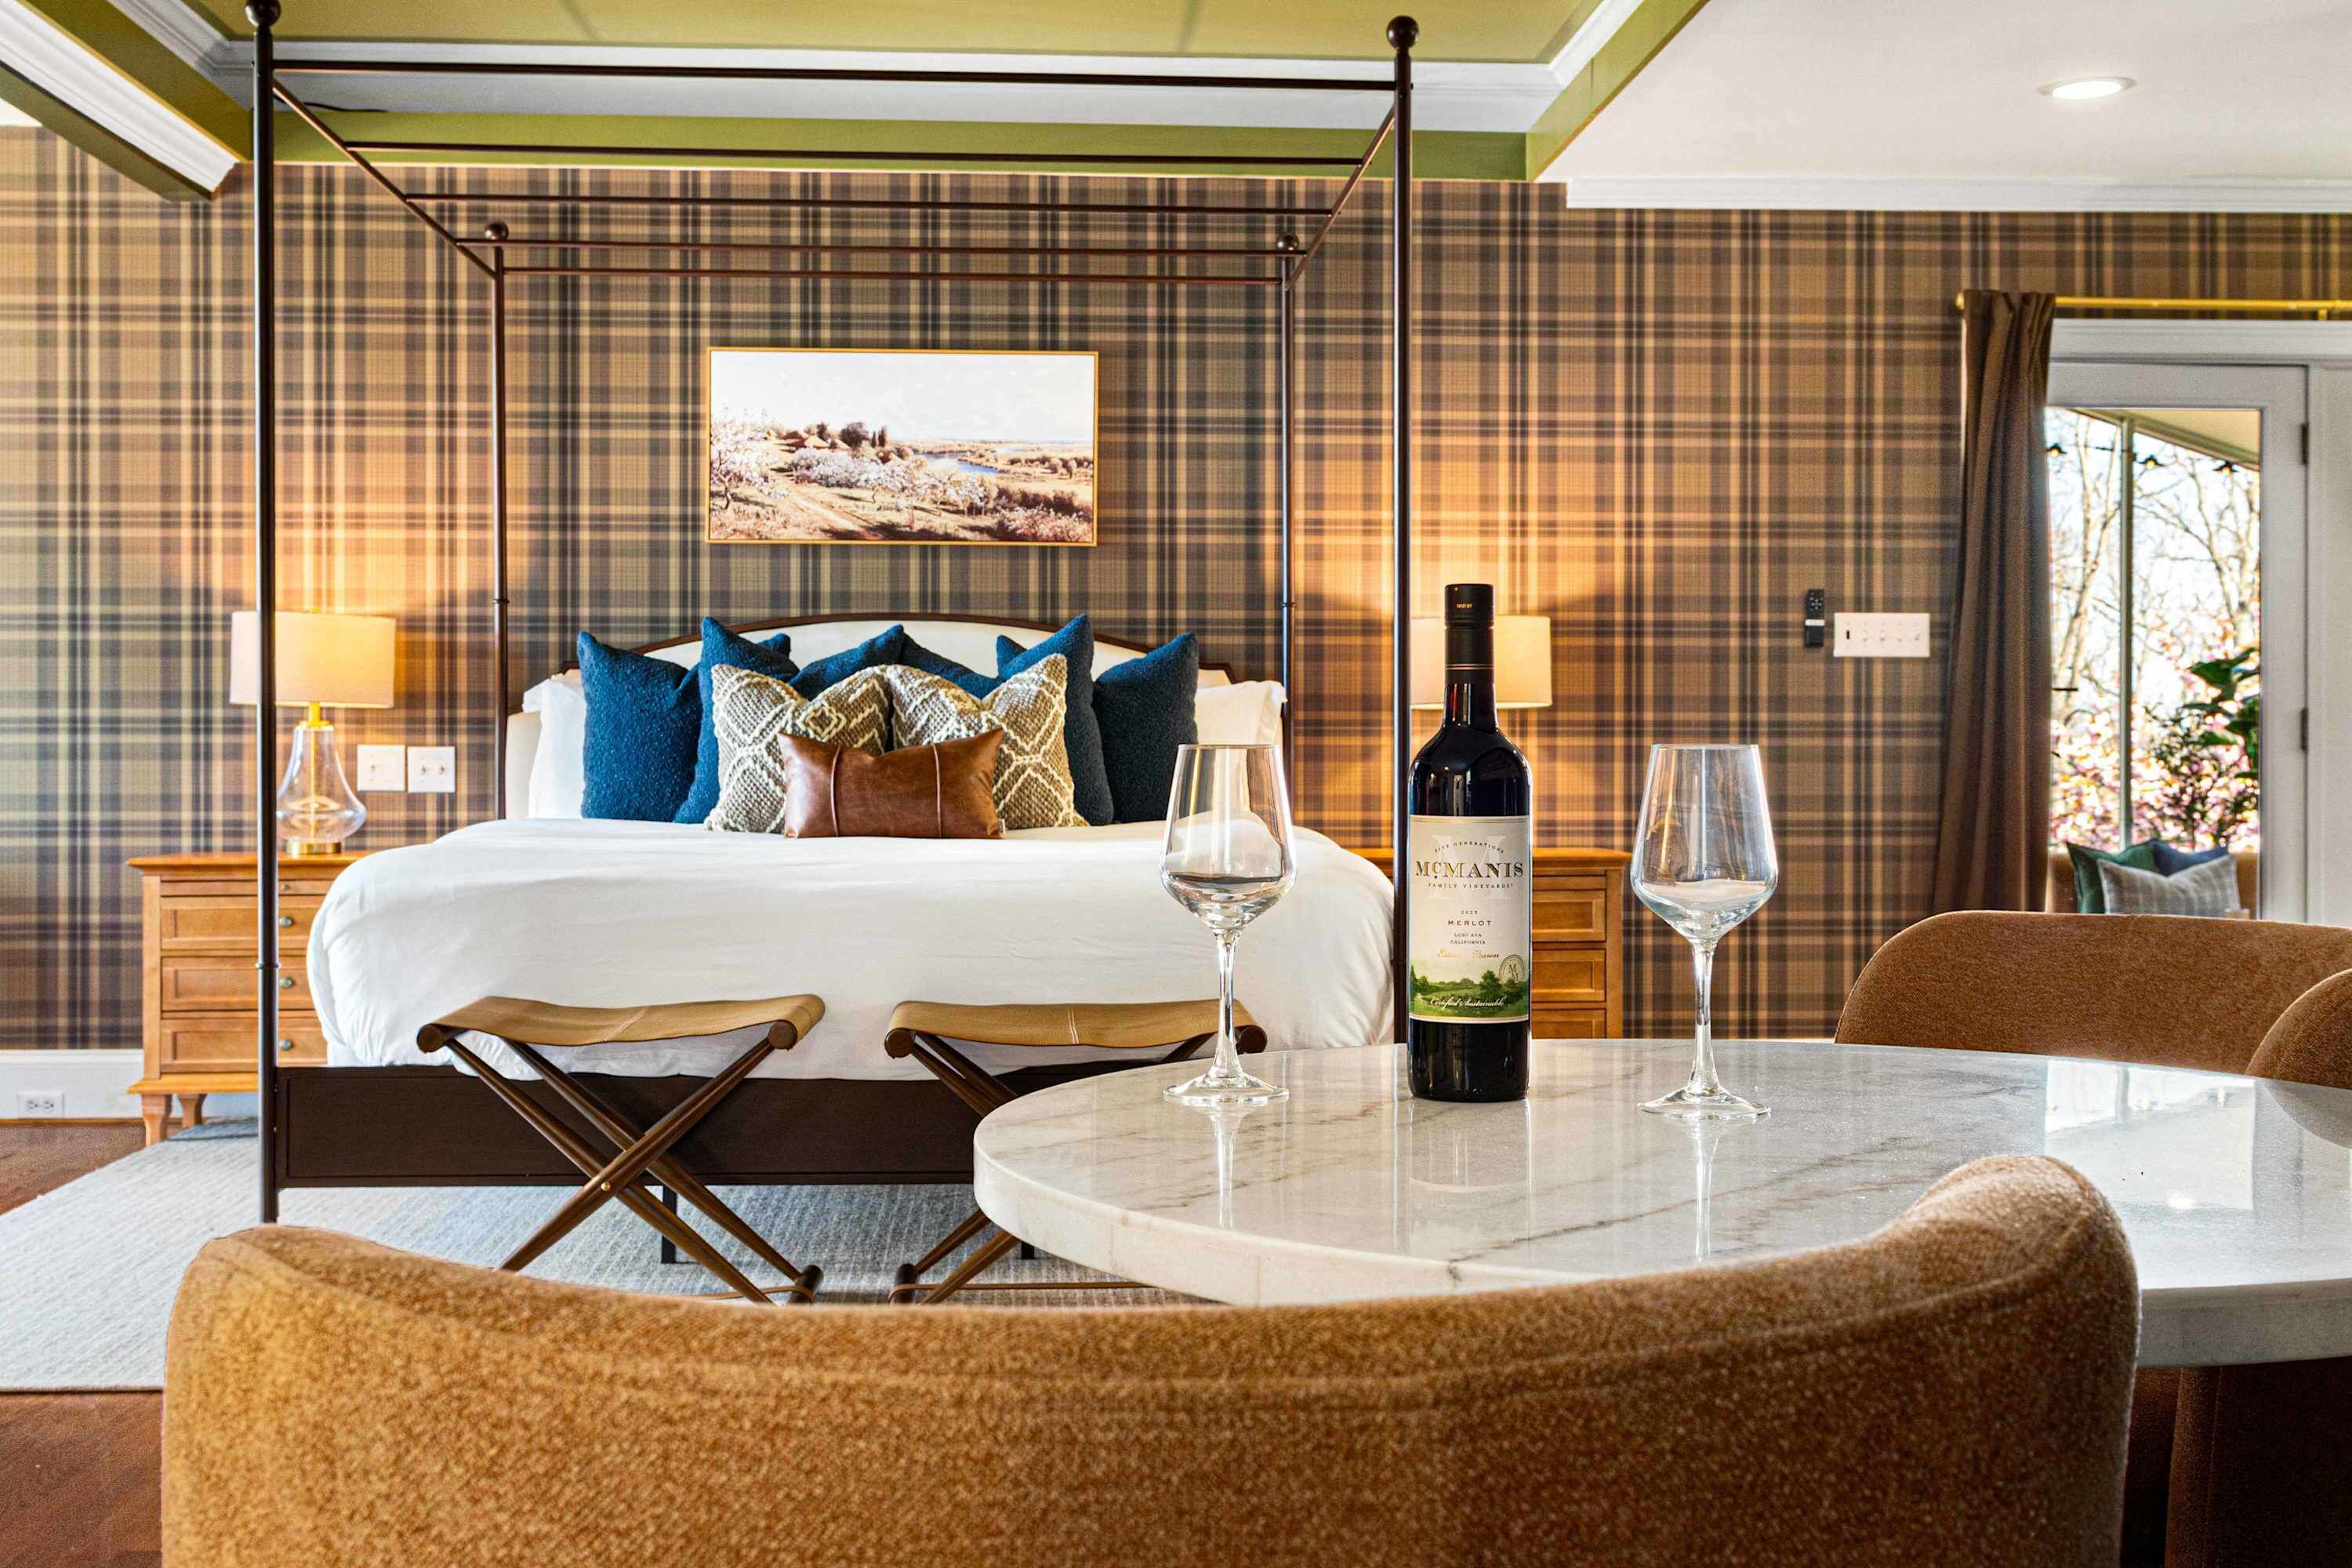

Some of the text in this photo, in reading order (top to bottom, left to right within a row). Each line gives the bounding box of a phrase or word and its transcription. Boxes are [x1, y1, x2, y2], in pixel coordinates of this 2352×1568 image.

[1434, 841, 1504, 854] FIVE GENERATIONS
[1430, 996, 1461, 1011] Certified
